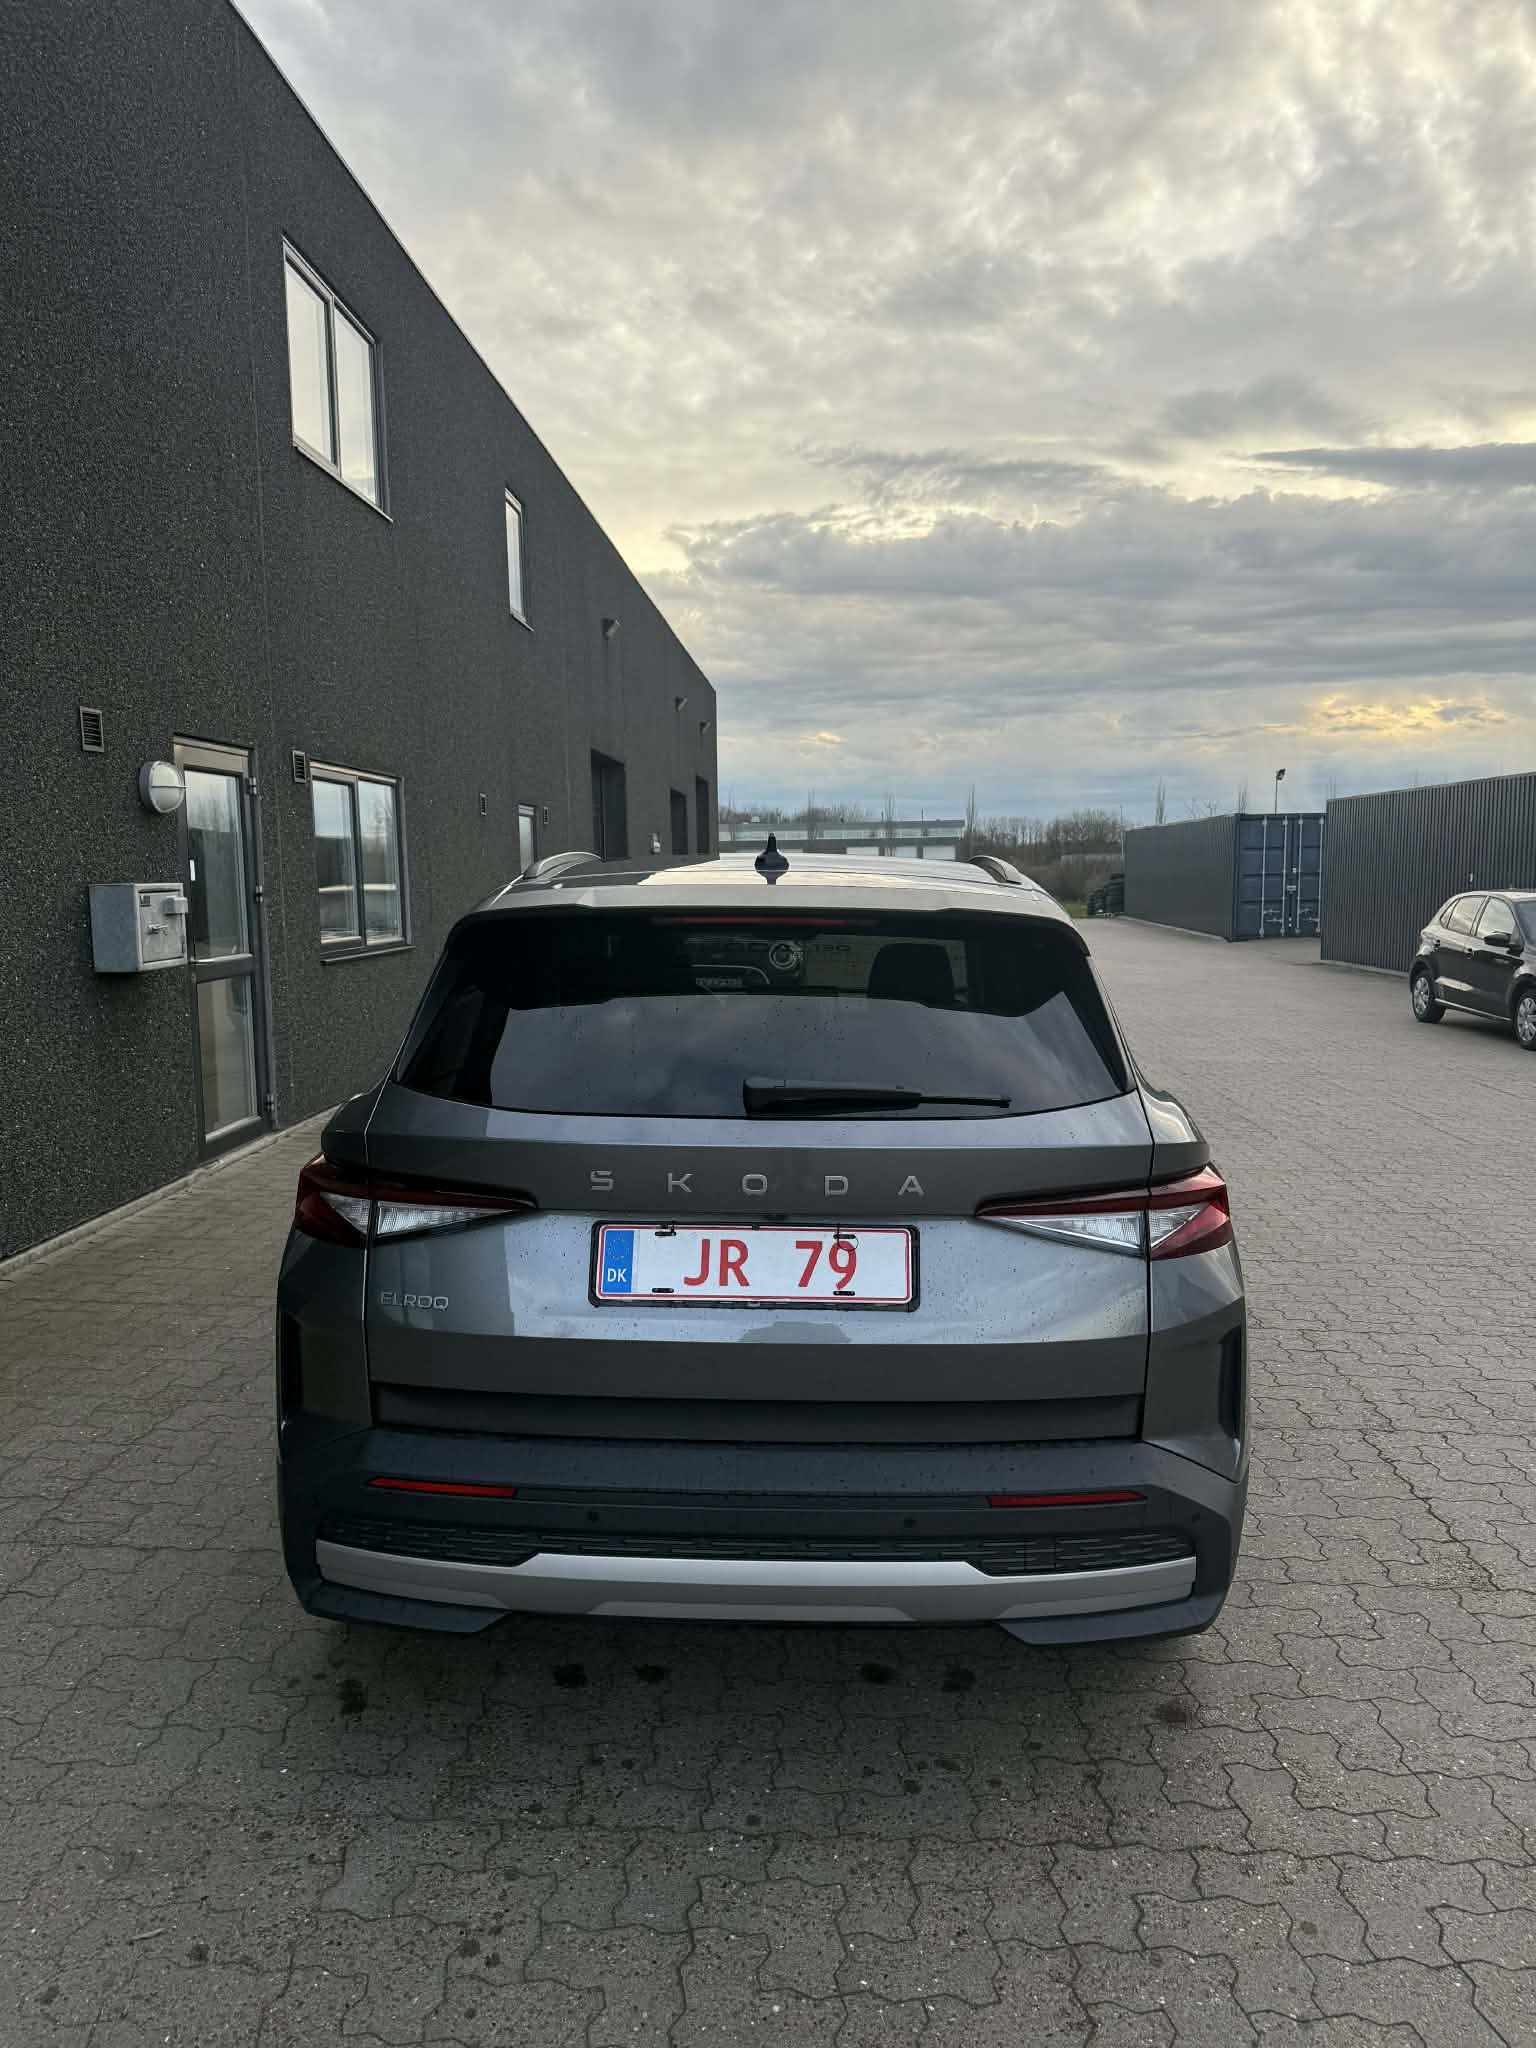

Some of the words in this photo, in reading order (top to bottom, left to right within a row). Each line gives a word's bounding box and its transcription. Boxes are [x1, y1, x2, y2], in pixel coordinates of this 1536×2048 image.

[590, 1169, 925, 1197] SKODA
[606, 1267, 627, 1283] DK
[684, 1238, 750, 1288] JR
[795, 1240, 857, 1291] 79
[380, 1290, 449, 1312] ELROQ
